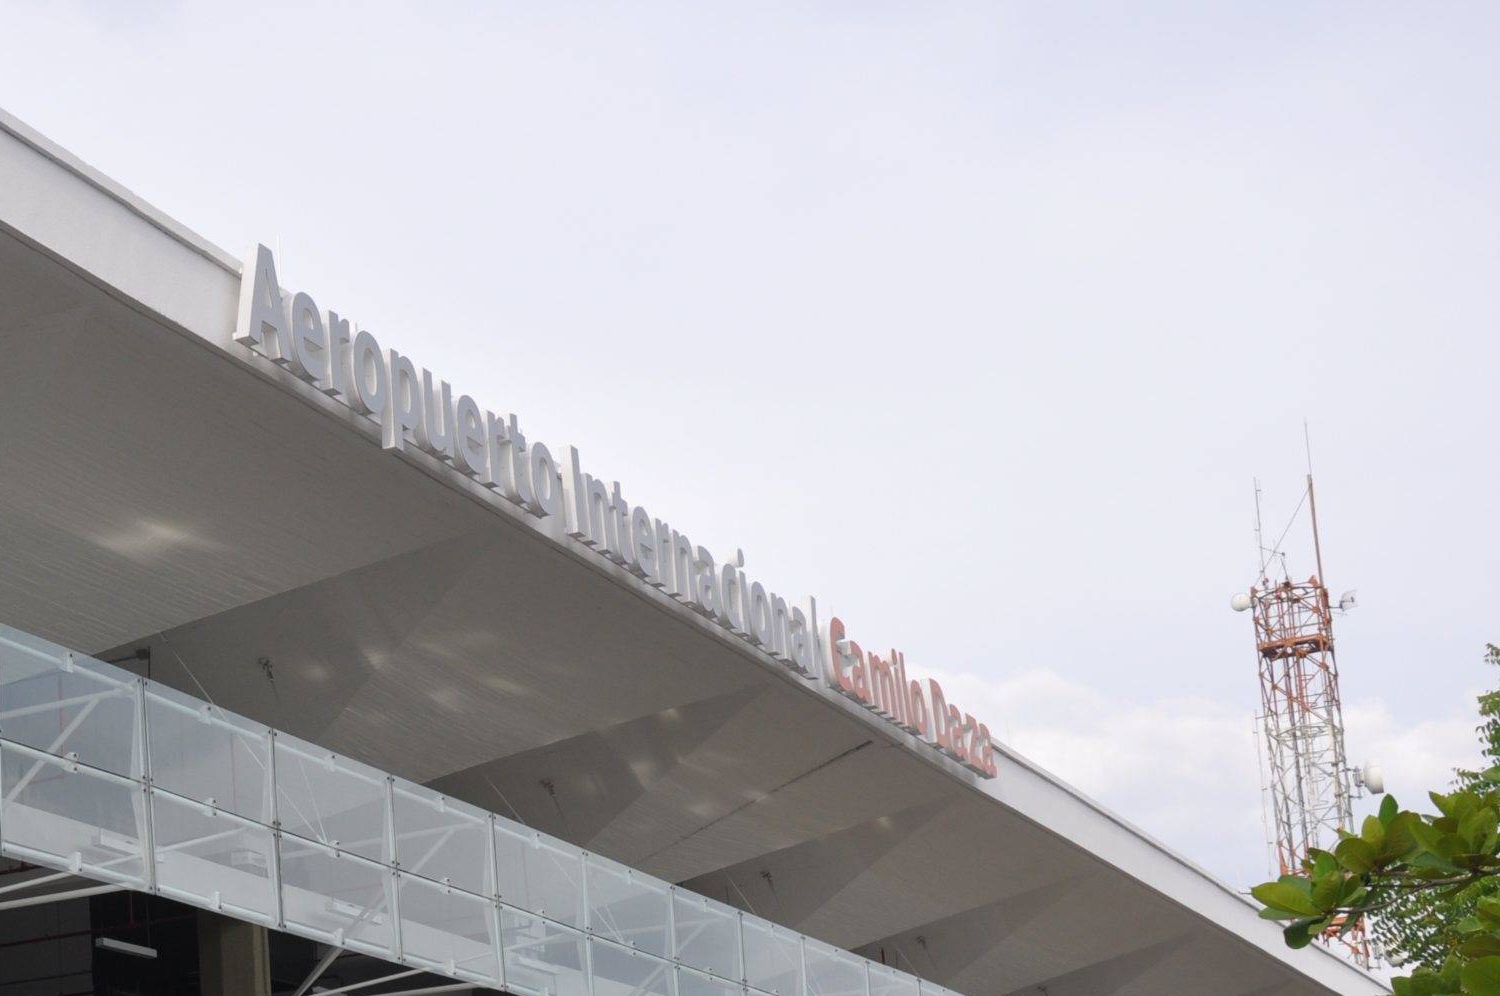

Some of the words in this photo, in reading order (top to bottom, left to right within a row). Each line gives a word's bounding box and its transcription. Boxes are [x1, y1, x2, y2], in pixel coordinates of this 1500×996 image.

[233, 243, 558, 517] Aeropuerto
[563, 445, 819, 679] Internacional
[826, 617, 927, 736] Camilo
[924, 678, 998, 779] Daza
